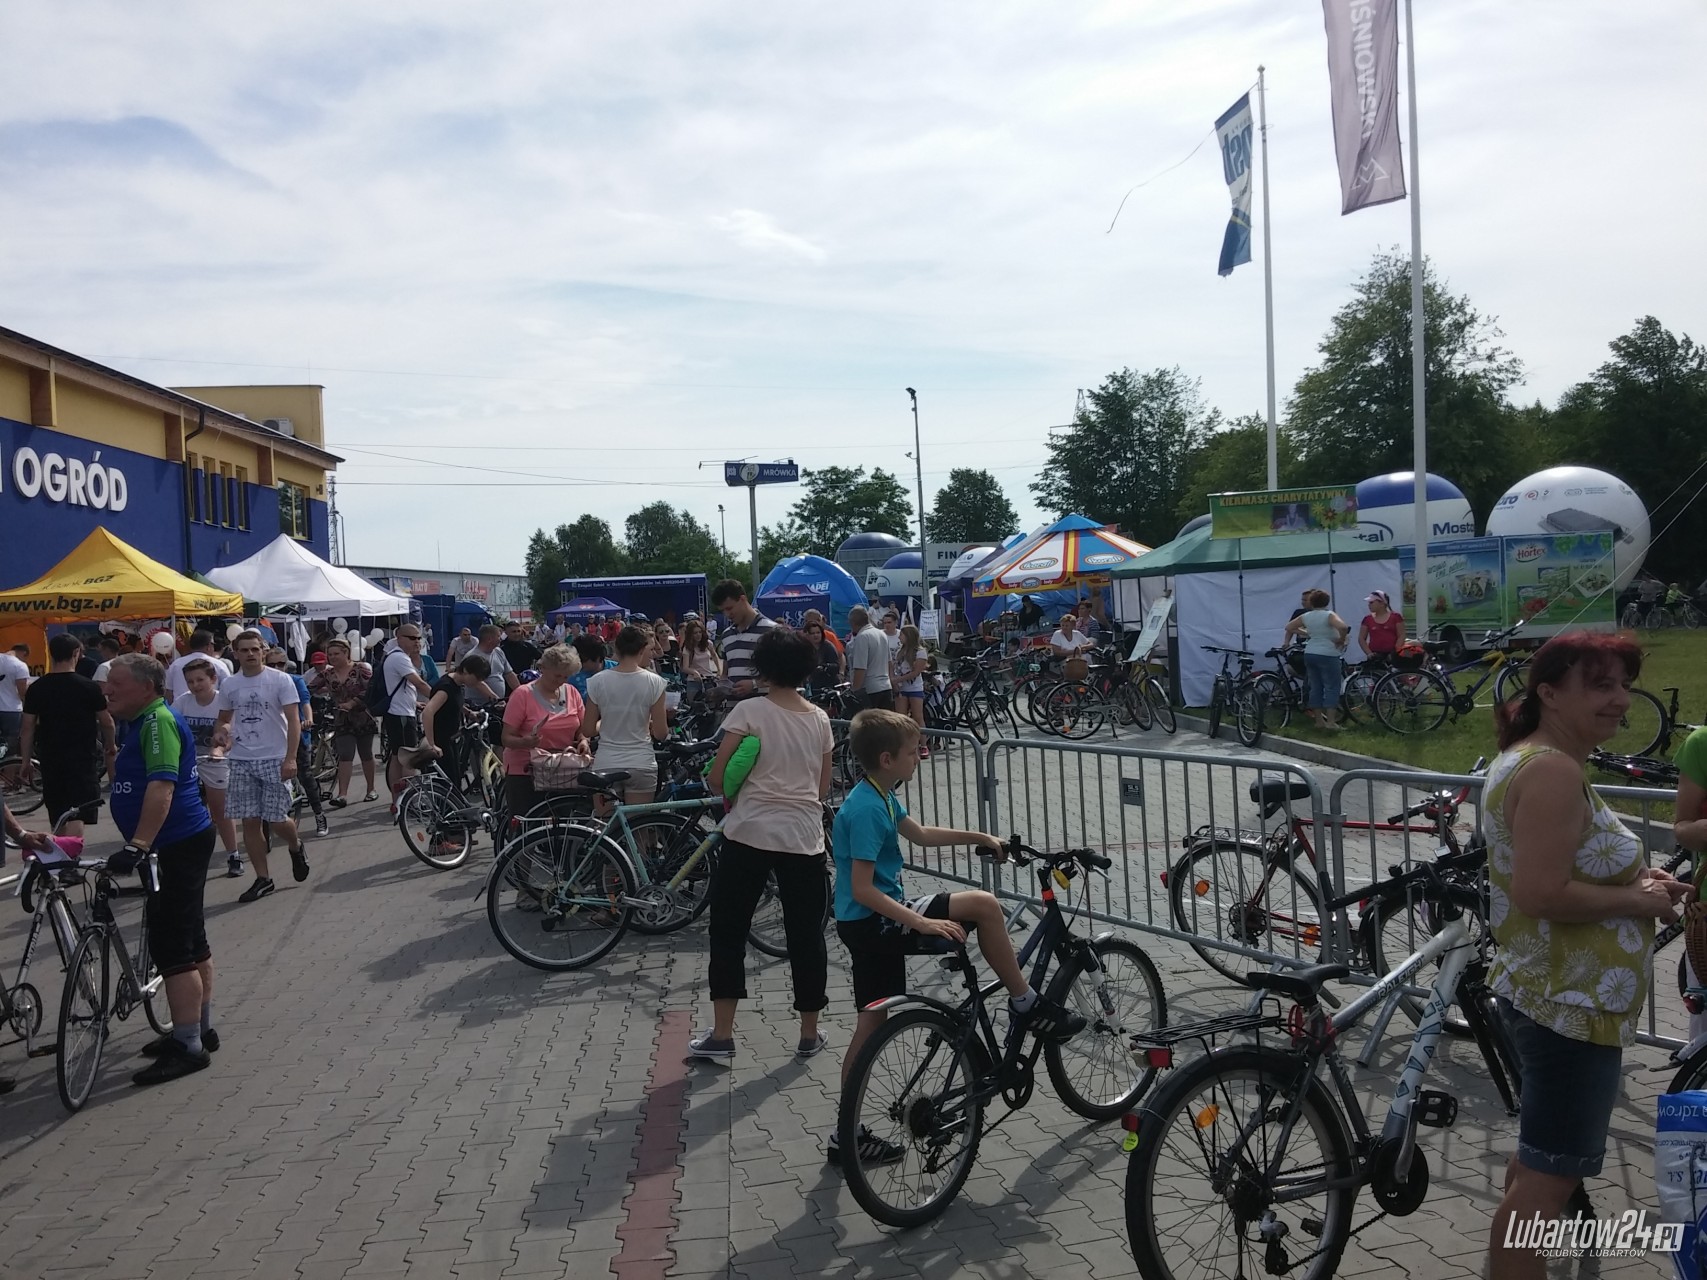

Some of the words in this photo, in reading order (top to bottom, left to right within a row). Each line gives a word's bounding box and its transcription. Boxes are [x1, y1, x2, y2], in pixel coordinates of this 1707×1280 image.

[12, 446, 127, 512] OGRÓD
[763, 467, 797, 477] MRÓWKA
[1220, 495, 1269, 507] KIERMASZ
[1271, 489, 1348, 503] CHARYTATYWNY
[1516, 546, 1547, 559] Hortex
[0, 595, 122, 613] www.bgz.pl
[151, 721, 160, 755] STILLADS
[1377, 957, 1424, 999] RALEIGH
